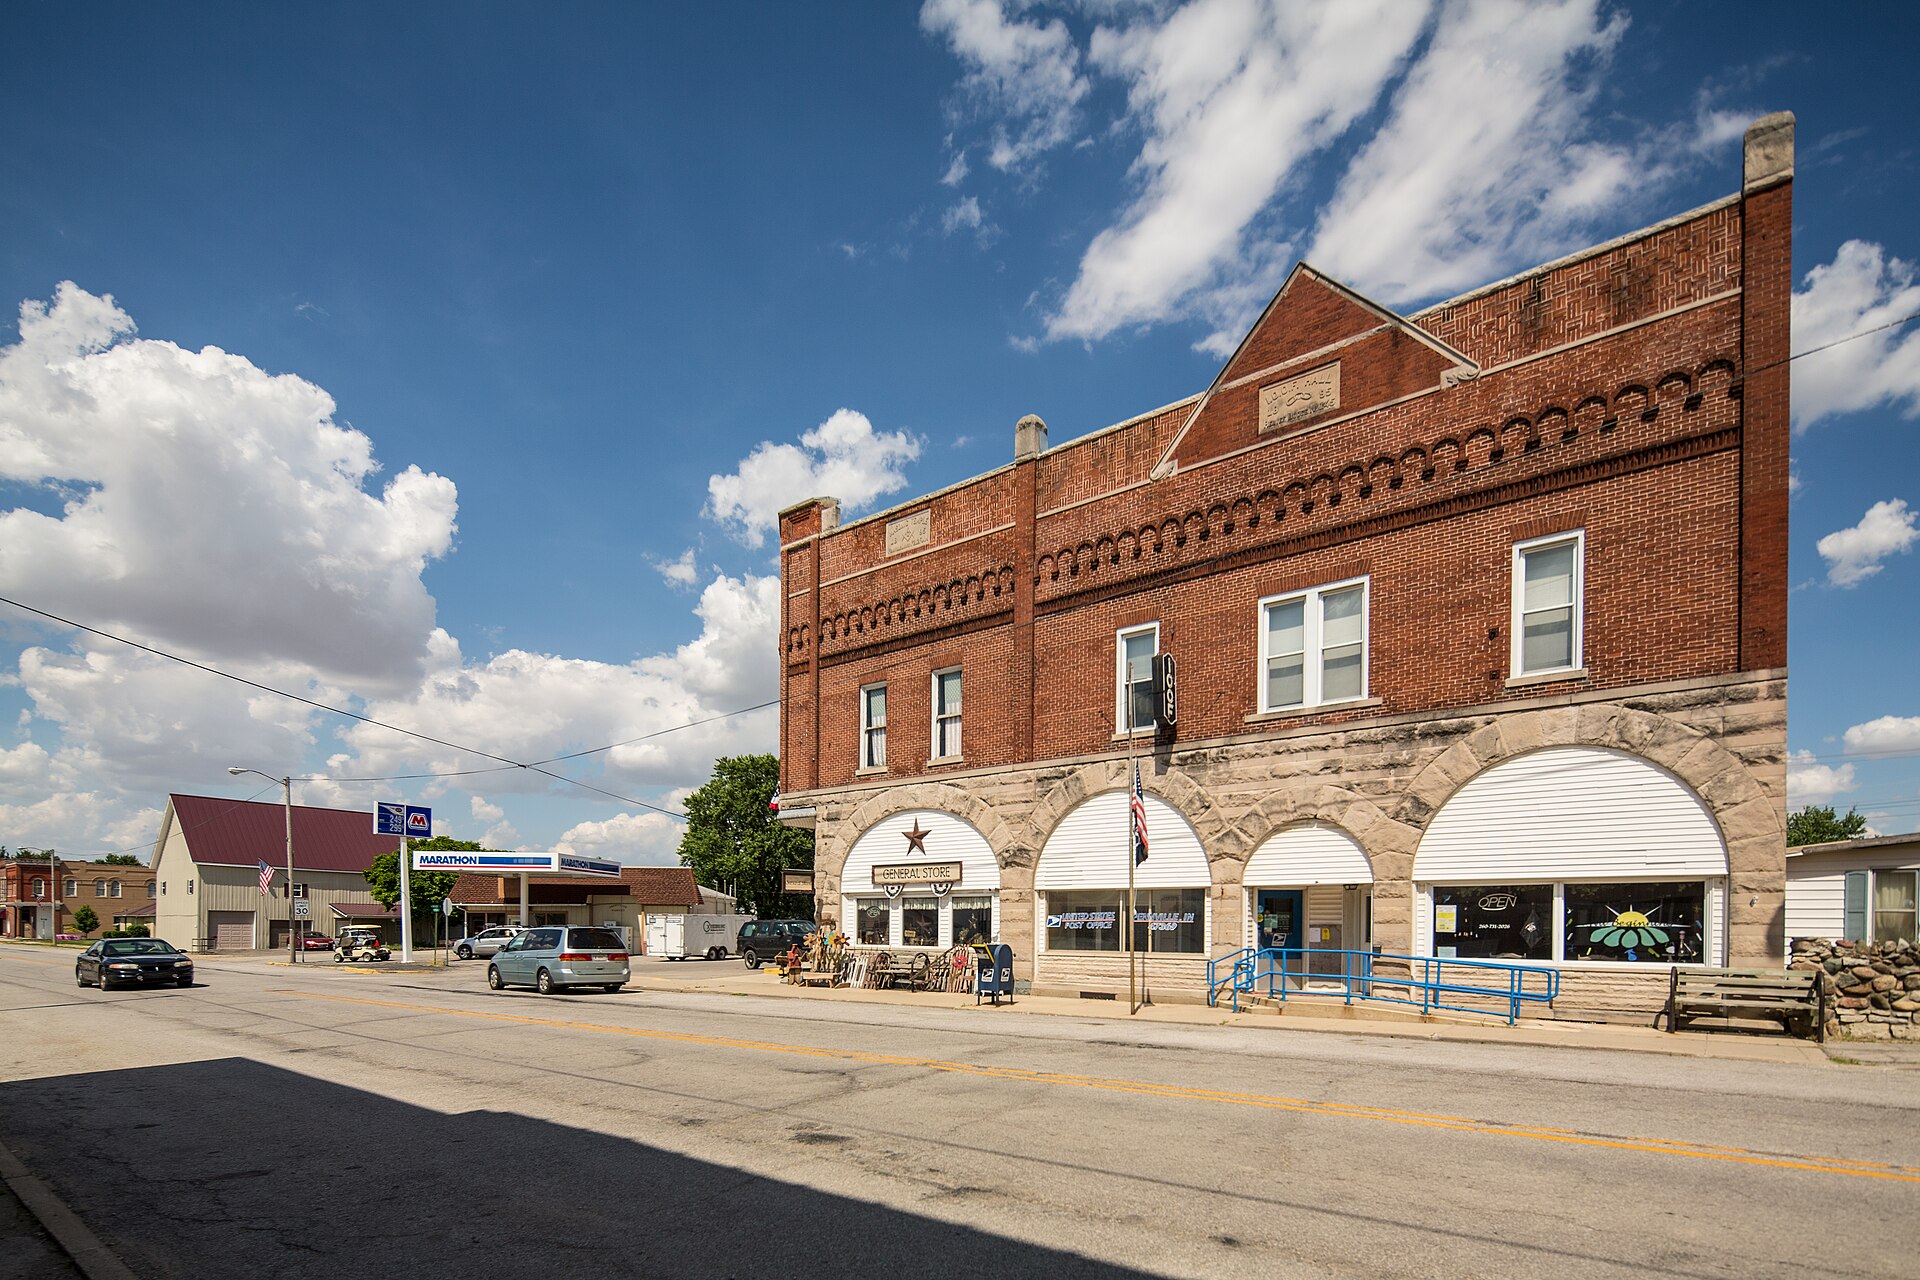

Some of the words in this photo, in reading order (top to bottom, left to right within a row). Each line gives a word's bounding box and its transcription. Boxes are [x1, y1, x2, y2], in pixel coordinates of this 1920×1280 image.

[419, 855, 478, 865] MARATHON
[560, 857, 590, 869] MARATHON
[882, 868, 921, 880] GENERAL
[922, 866, 951, 878] STORE
[1478, 896, 1517, 908] OPEN
[295, 907, 309, 915] 30
[1062, 912, 1089, 921] UNITED
[1090, 911, 1116, 920] STATES
[1183, 912, 1195, 922] IN
[1086, 921, 1113, 929] OFFICE
